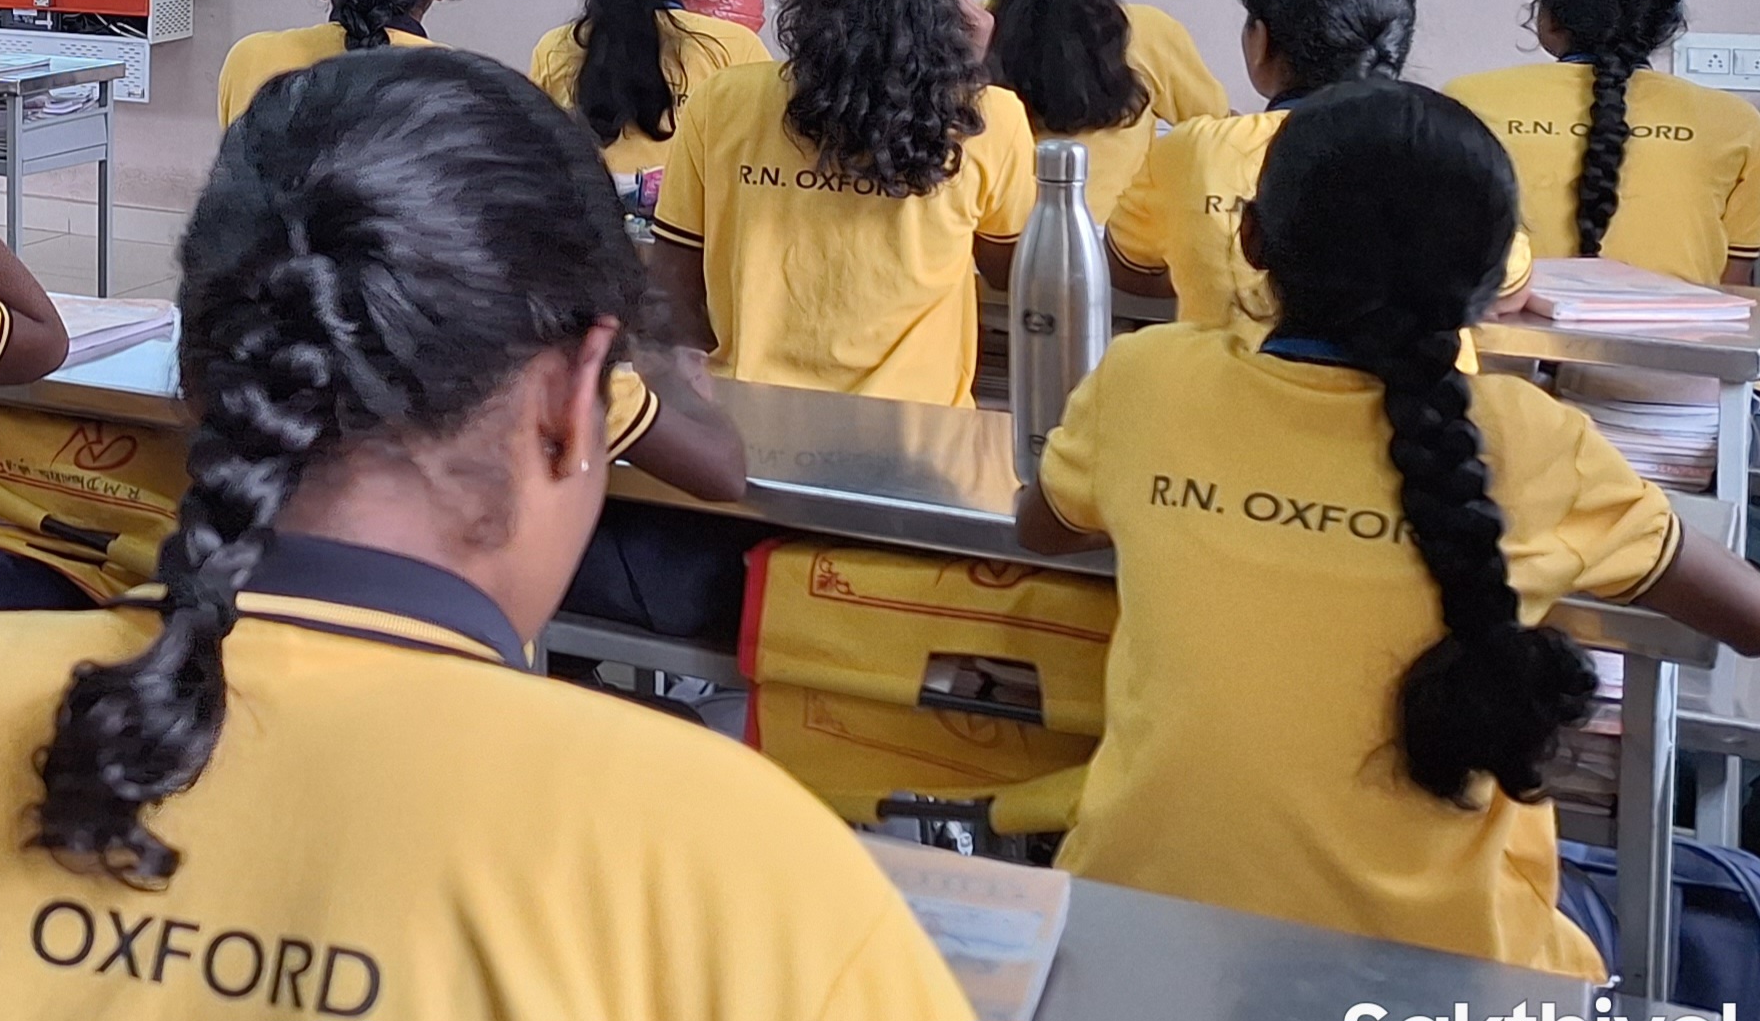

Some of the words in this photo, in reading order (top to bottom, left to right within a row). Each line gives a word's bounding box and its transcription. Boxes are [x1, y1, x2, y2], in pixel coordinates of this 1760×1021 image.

[1507, 120, 1561, 136] R.N.
[1570, 122, 1695, 142] OORD
[739, 165, 787, 187] R.N.
[1150, 475, 1225, 515] R.N.
[30, 899, 381, 1018] OXFORD
